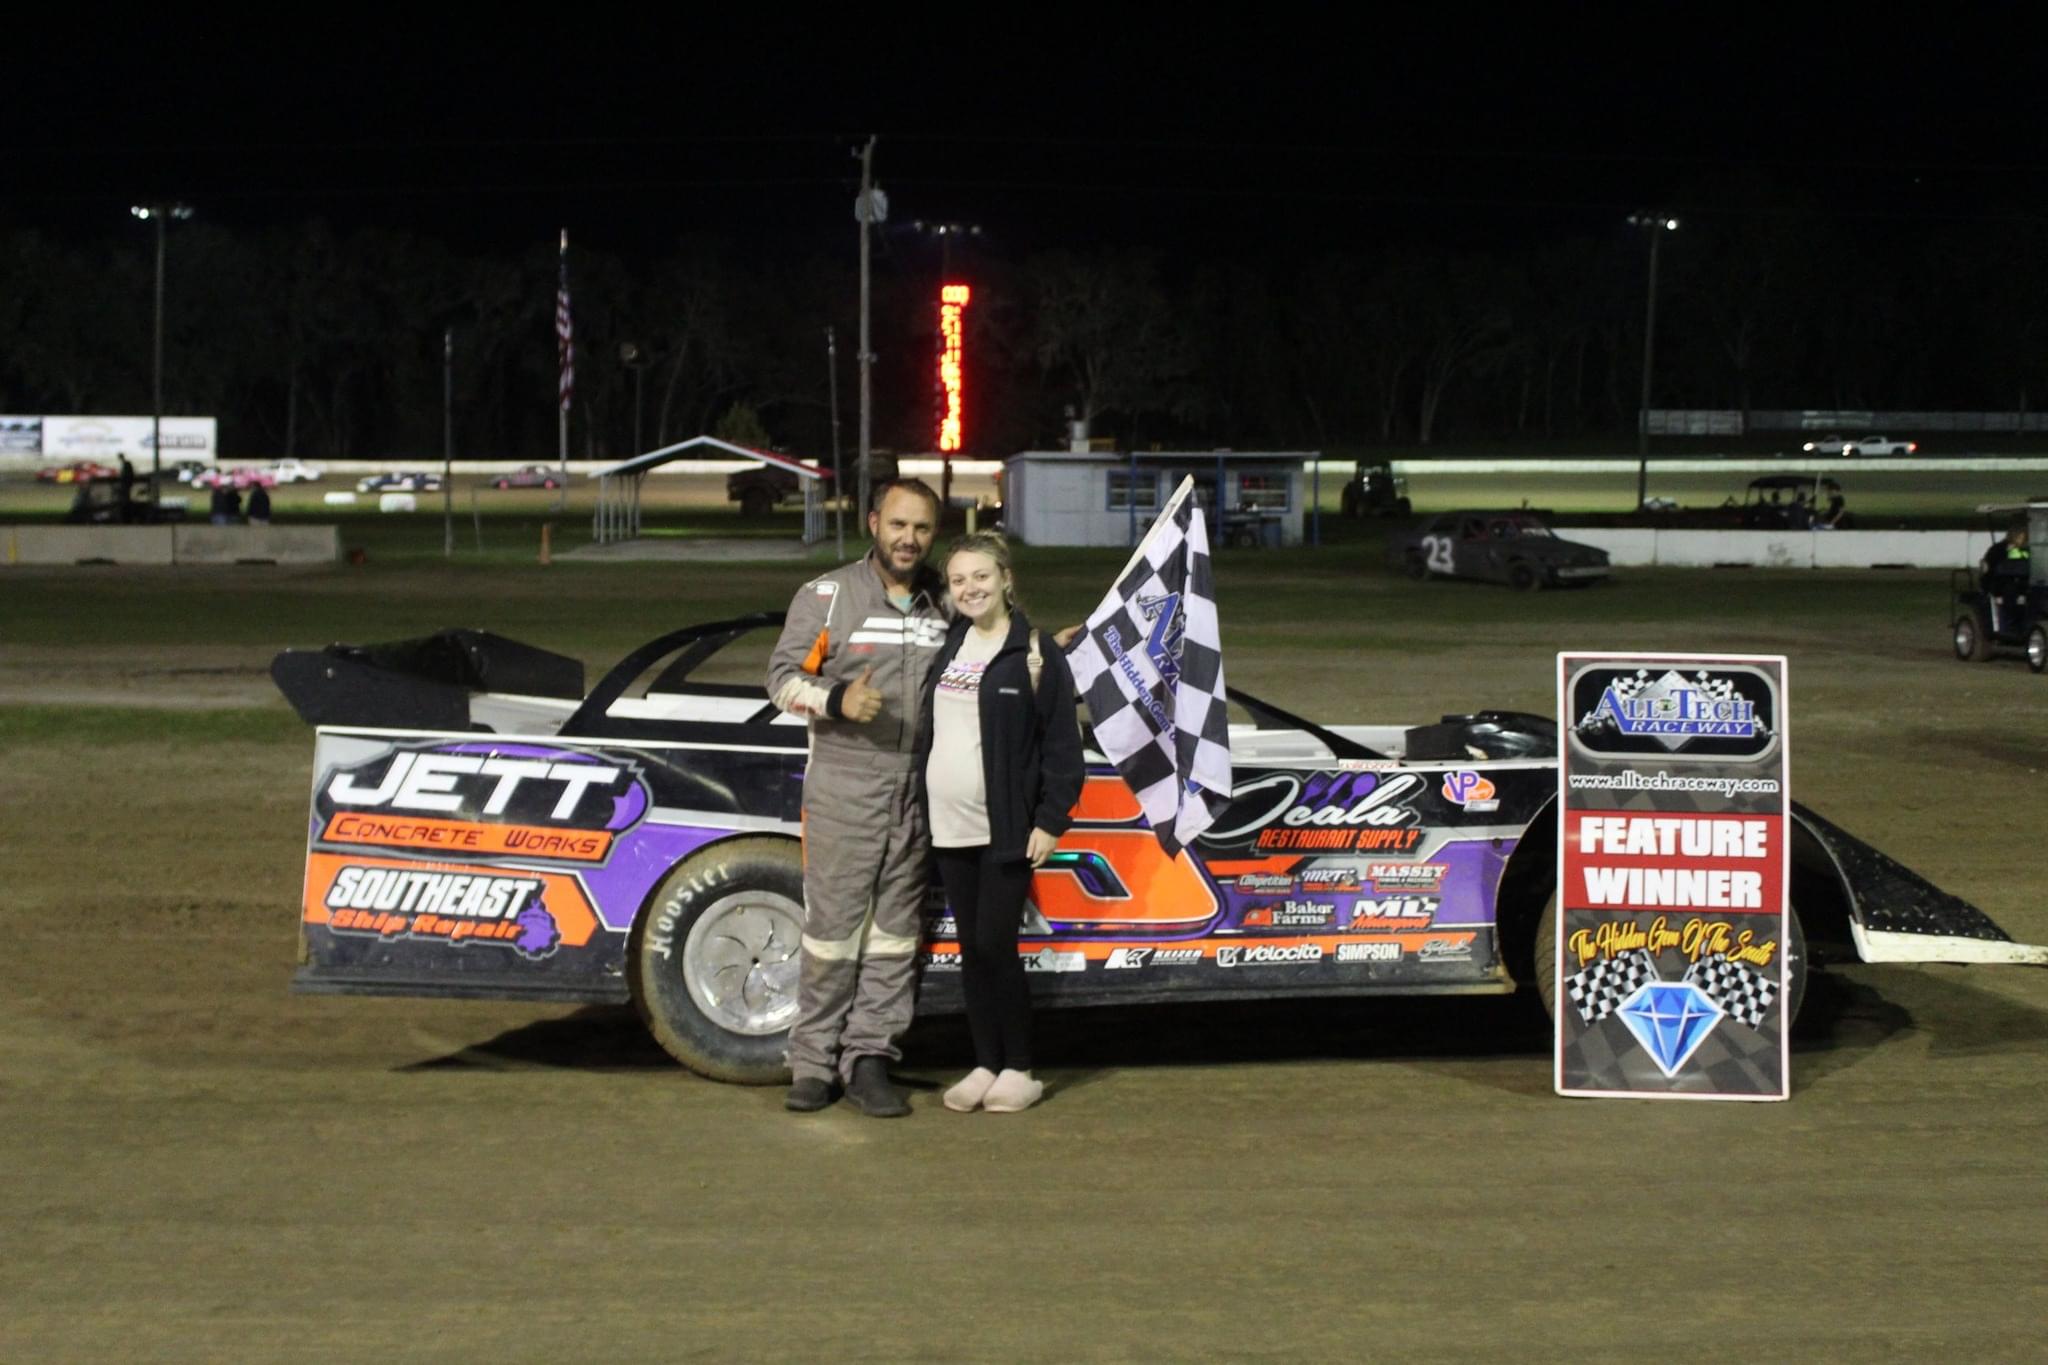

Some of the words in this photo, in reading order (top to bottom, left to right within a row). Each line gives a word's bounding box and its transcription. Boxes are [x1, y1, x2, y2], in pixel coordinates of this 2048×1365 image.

[1421, 535, 1454, 573] 23
[1103, 624, 1124, 660] The
[1119, 653, 1152, 708] Hidden
[1150, 701, 1172, 732] Gem
[1631, 721, 1747, 734] RACEWAY
[327, 752, 620, 820] JETT
[1443, 771, 1480, 804] VP
[1569, 770, 1779, 797] www.alltechraceway.com
[334, 816, 484, 846] CONCRETE
[504, 828, 599, 854] WORKS
[1256, 829, 1355, 848] RESTAURANT
[1356, 829, 1420, 848] SUPPLY
[1580, 816, 1767, 858] FEATURE
[1370, 865, 1447, 878] MASSEY
[1583, 867, 1763, 908] WINNER
[327, 867, 539, 920] SOUTHEAST
[649, 860, 730, 961] Hoosier
[1284, 901, 1335, 914] Baker
[330, 909, 406, 935] Ship
[411, 913, 523, 941] Repair
[1272, 911, 1326, 925] Farms
[1337, 943, 1400, 960] SIMPSON
[1569, 929, 1597, 967] The
[1597, 922, 1648, 960] Hidden
[1648, 916, 1681, 958] Gem
